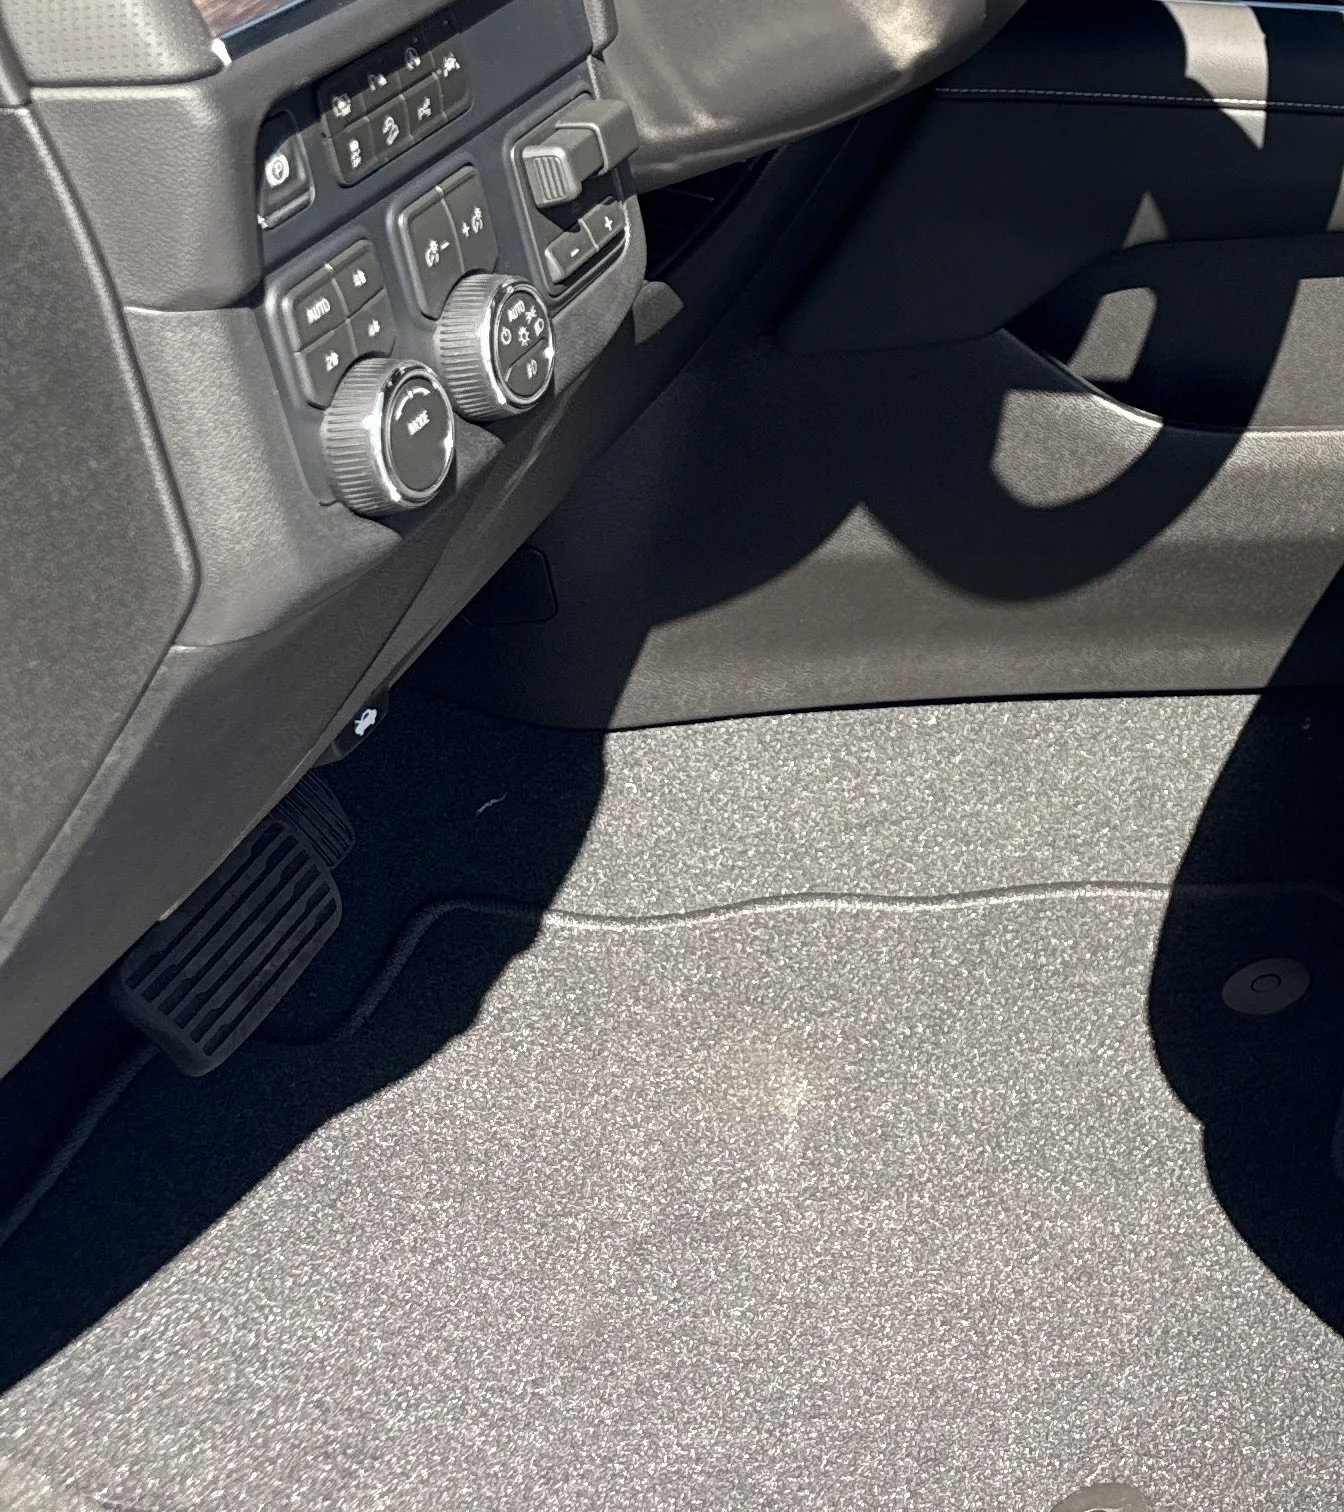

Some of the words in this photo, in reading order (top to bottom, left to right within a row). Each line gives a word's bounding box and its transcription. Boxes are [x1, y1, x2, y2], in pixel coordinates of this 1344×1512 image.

[306, 297, 331, 324] AUTO
[507, 299, 526, 323] AUTO
[407, 409, 431, 437] MODE
